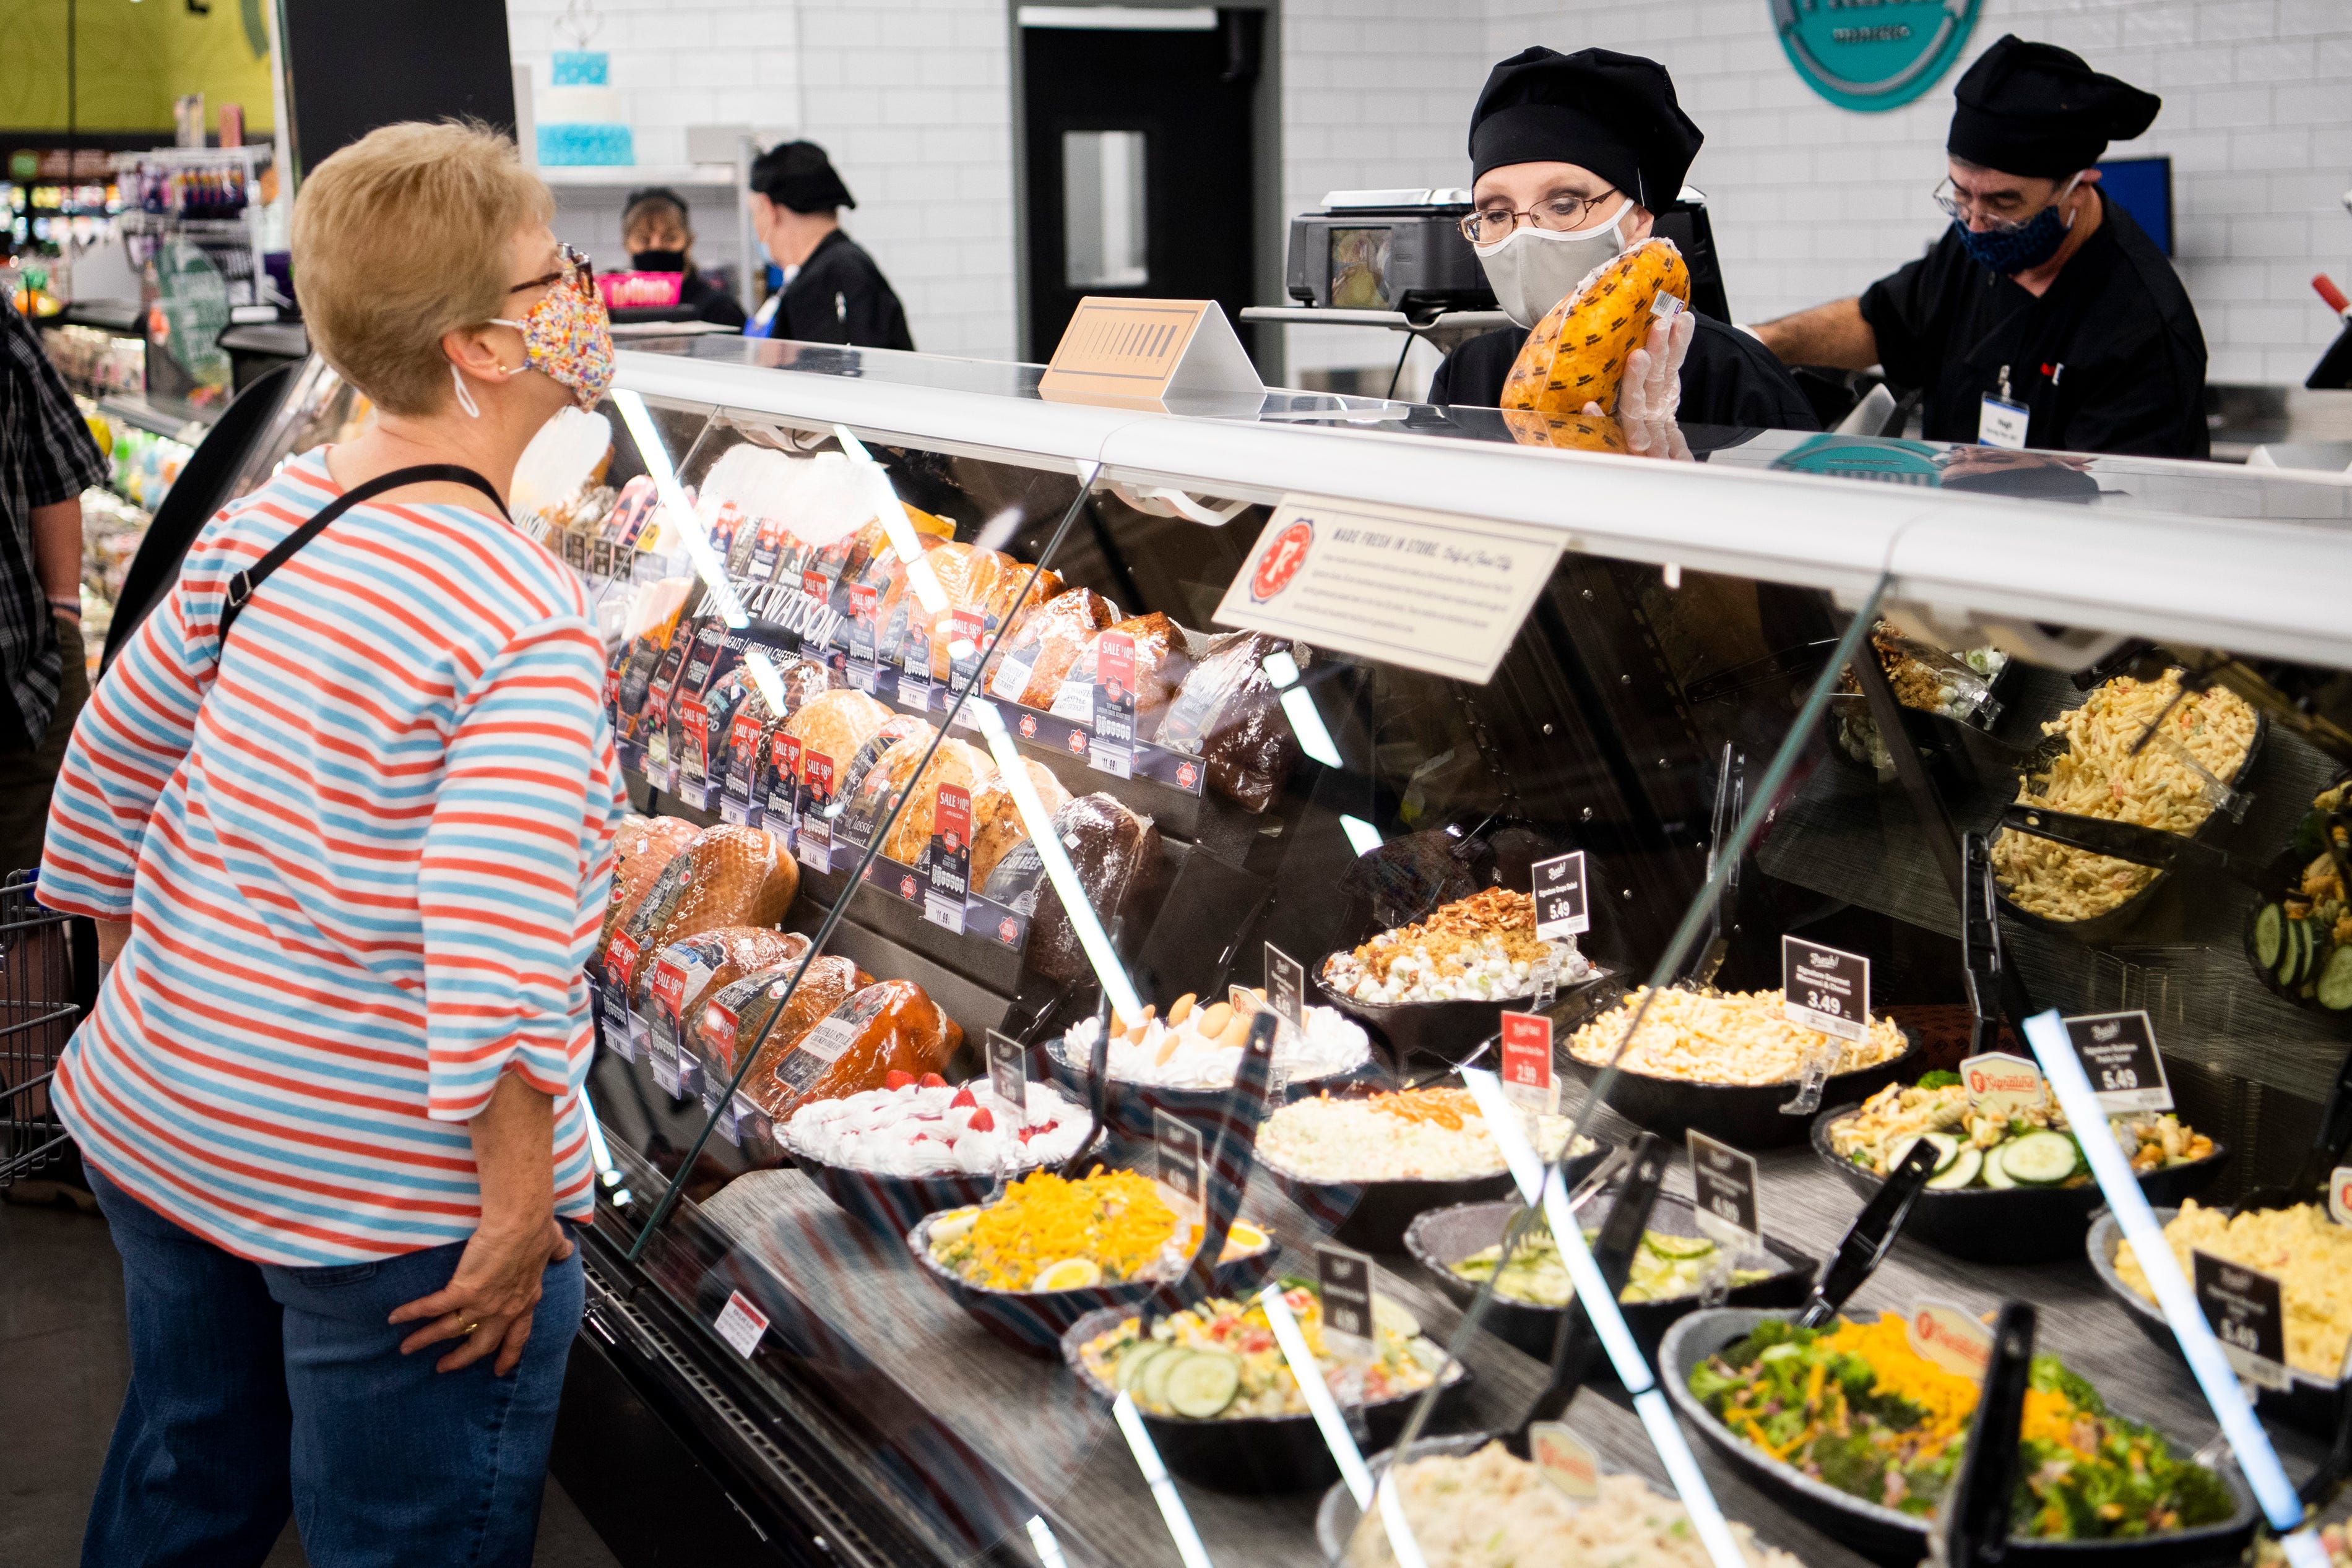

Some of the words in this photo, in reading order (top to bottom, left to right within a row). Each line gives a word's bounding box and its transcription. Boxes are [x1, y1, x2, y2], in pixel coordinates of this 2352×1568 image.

[1360, 532, 1393, 548] FRESH
[805, 578, 816, 591] SALE
[852, 592, 864, 606] SALE
[761, 584, 847, 652] WATSON
[953, 618, 967, 634] SALE
[696, 627, 727, 645] PREMIUM
[724, 633, 745, 651] MEATS
[743, 641, 775, 657] ARTISAN
[771, 648, 802, 663] CHEESES
[1102, 641, 1120, 656] SALE
[684, 707, 695, 723] SALE
[734, 723, 748, 739] SALE
[774, 741, 787, 757] SALE
[806, 759, 819, 775] SALE
[940, 792, 956, 808] SALE
[849, 814, 874, 834] Classic
[1019, 856, 1043, 871] BEEF
[1549, 900, 1570, 920] 5.49
[610, 937, 623, 958] SALE
[1810, 952, 1840, 970] Fresh!
[655, 971, 670, 989] SALE
[1796, 964, 1825, 980] Signature
[1825, 973, 1851, 988] Gourmet
[1796, 972, 1823, 987] Macaroni
[1829, 983, 1853, 996] Cheese
[1807, 991, 1841, 1015] 3.49
[1517, 1064, 1537, 1083] 2.99
[1984, 1072, 2037, 1093] Signature
[2102, 1068, 2138, 1090] 5.49
